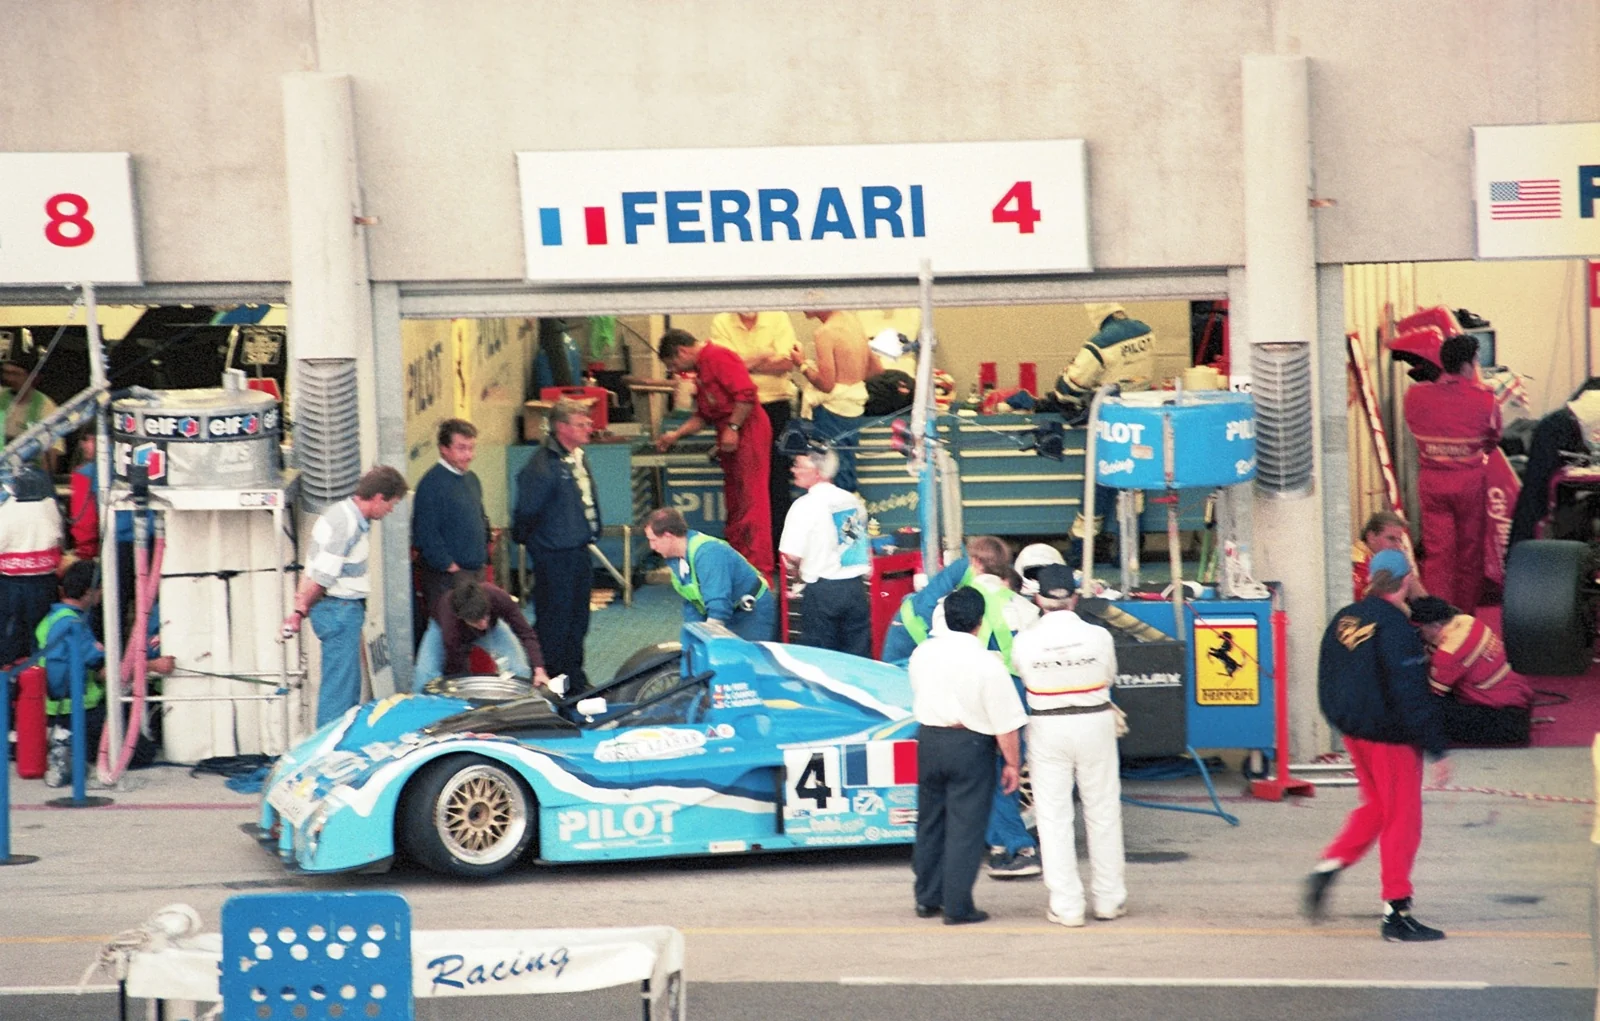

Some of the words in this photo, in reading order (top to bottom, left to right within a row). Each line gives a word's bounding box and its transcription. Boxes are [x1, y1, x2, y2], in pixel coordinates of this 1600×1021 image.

[44, 192, 95, 248] 8
[621, 184, 926, 245] FERRARI
[991, 180, 1042, 235] 4
[795, 752, 832, 809] 4
[558, 803, 681, 842] PILOT
[427, 945, 570, 994] Racing
